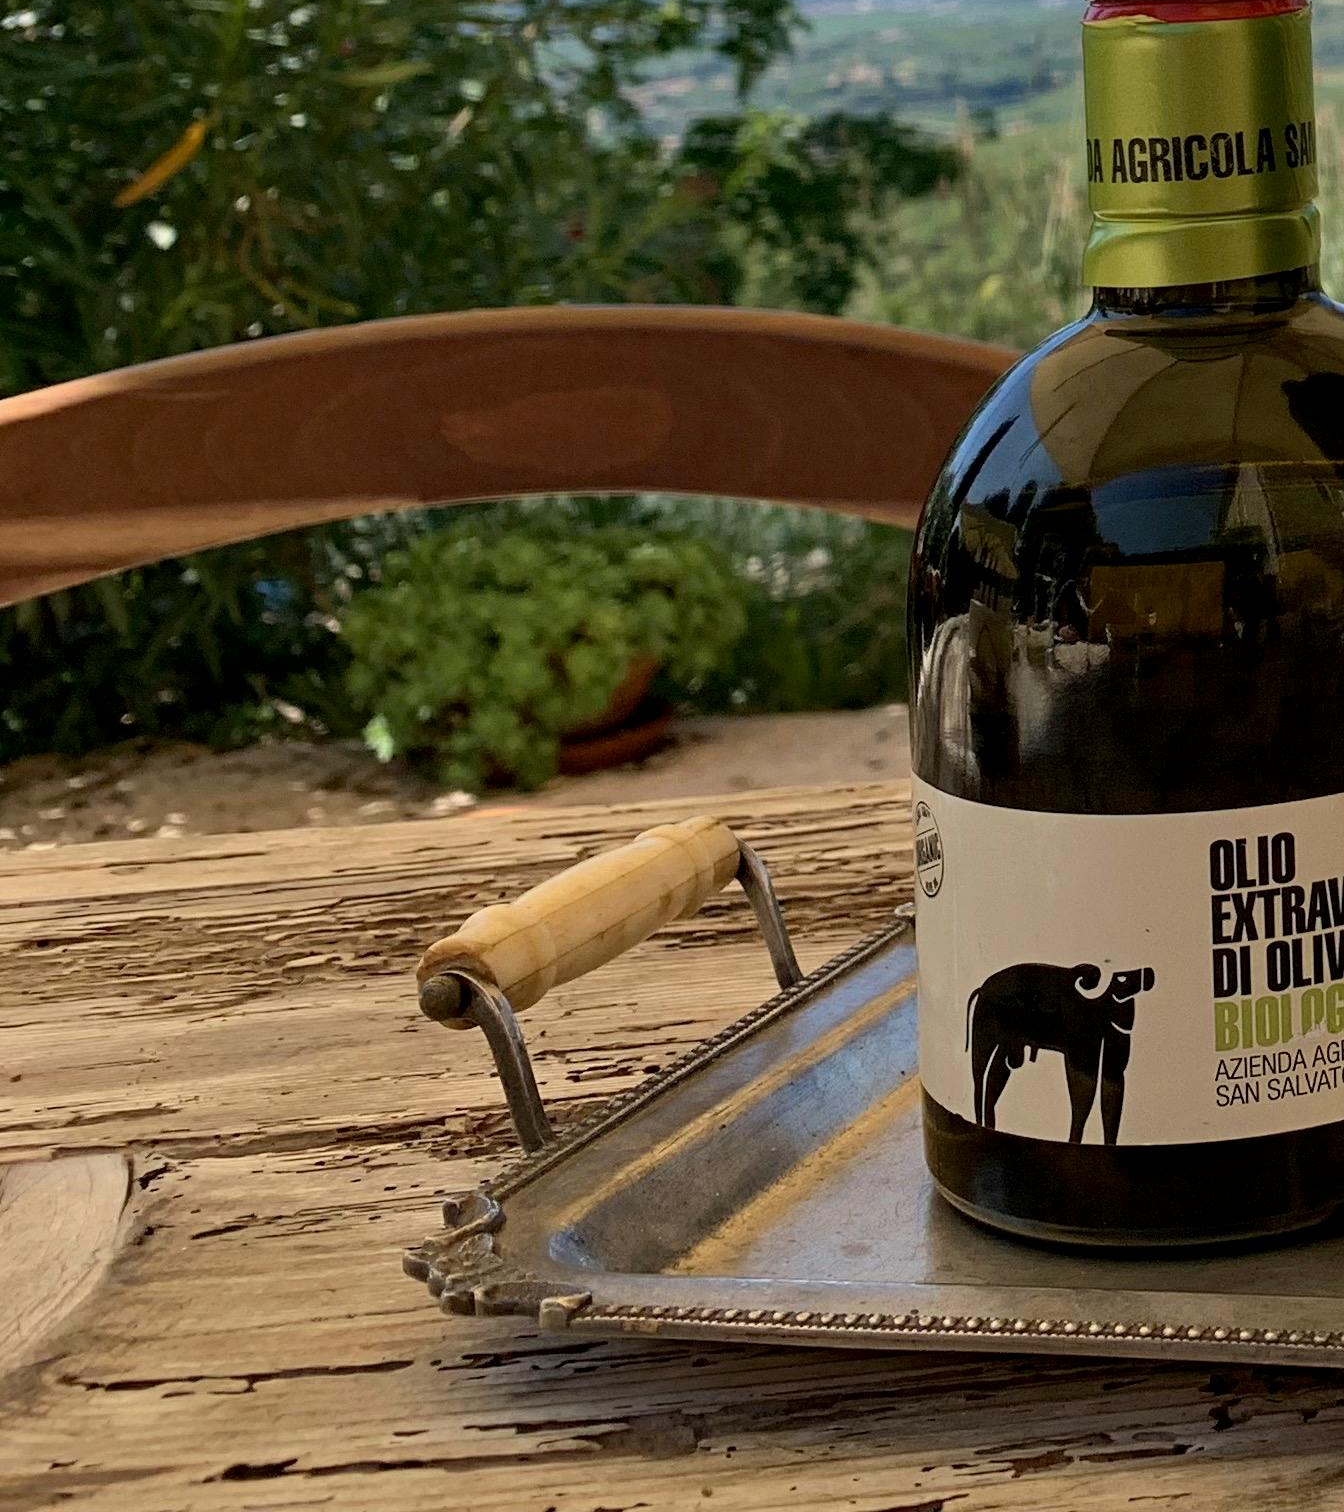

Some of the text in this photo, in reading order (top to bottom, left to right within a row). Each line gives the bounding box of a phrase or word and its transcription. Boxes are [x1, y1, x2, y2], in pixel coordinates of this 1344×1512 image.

[1111, 127, 1276, 184] AGRICOLA
[1209, 832, 1296, 891] OLIO
[1212, 946, 1252, 998] DI
[1215, 1049, 1308, 1081] AZIENDA
[1215, 1081, 1260, 1107] SAN
